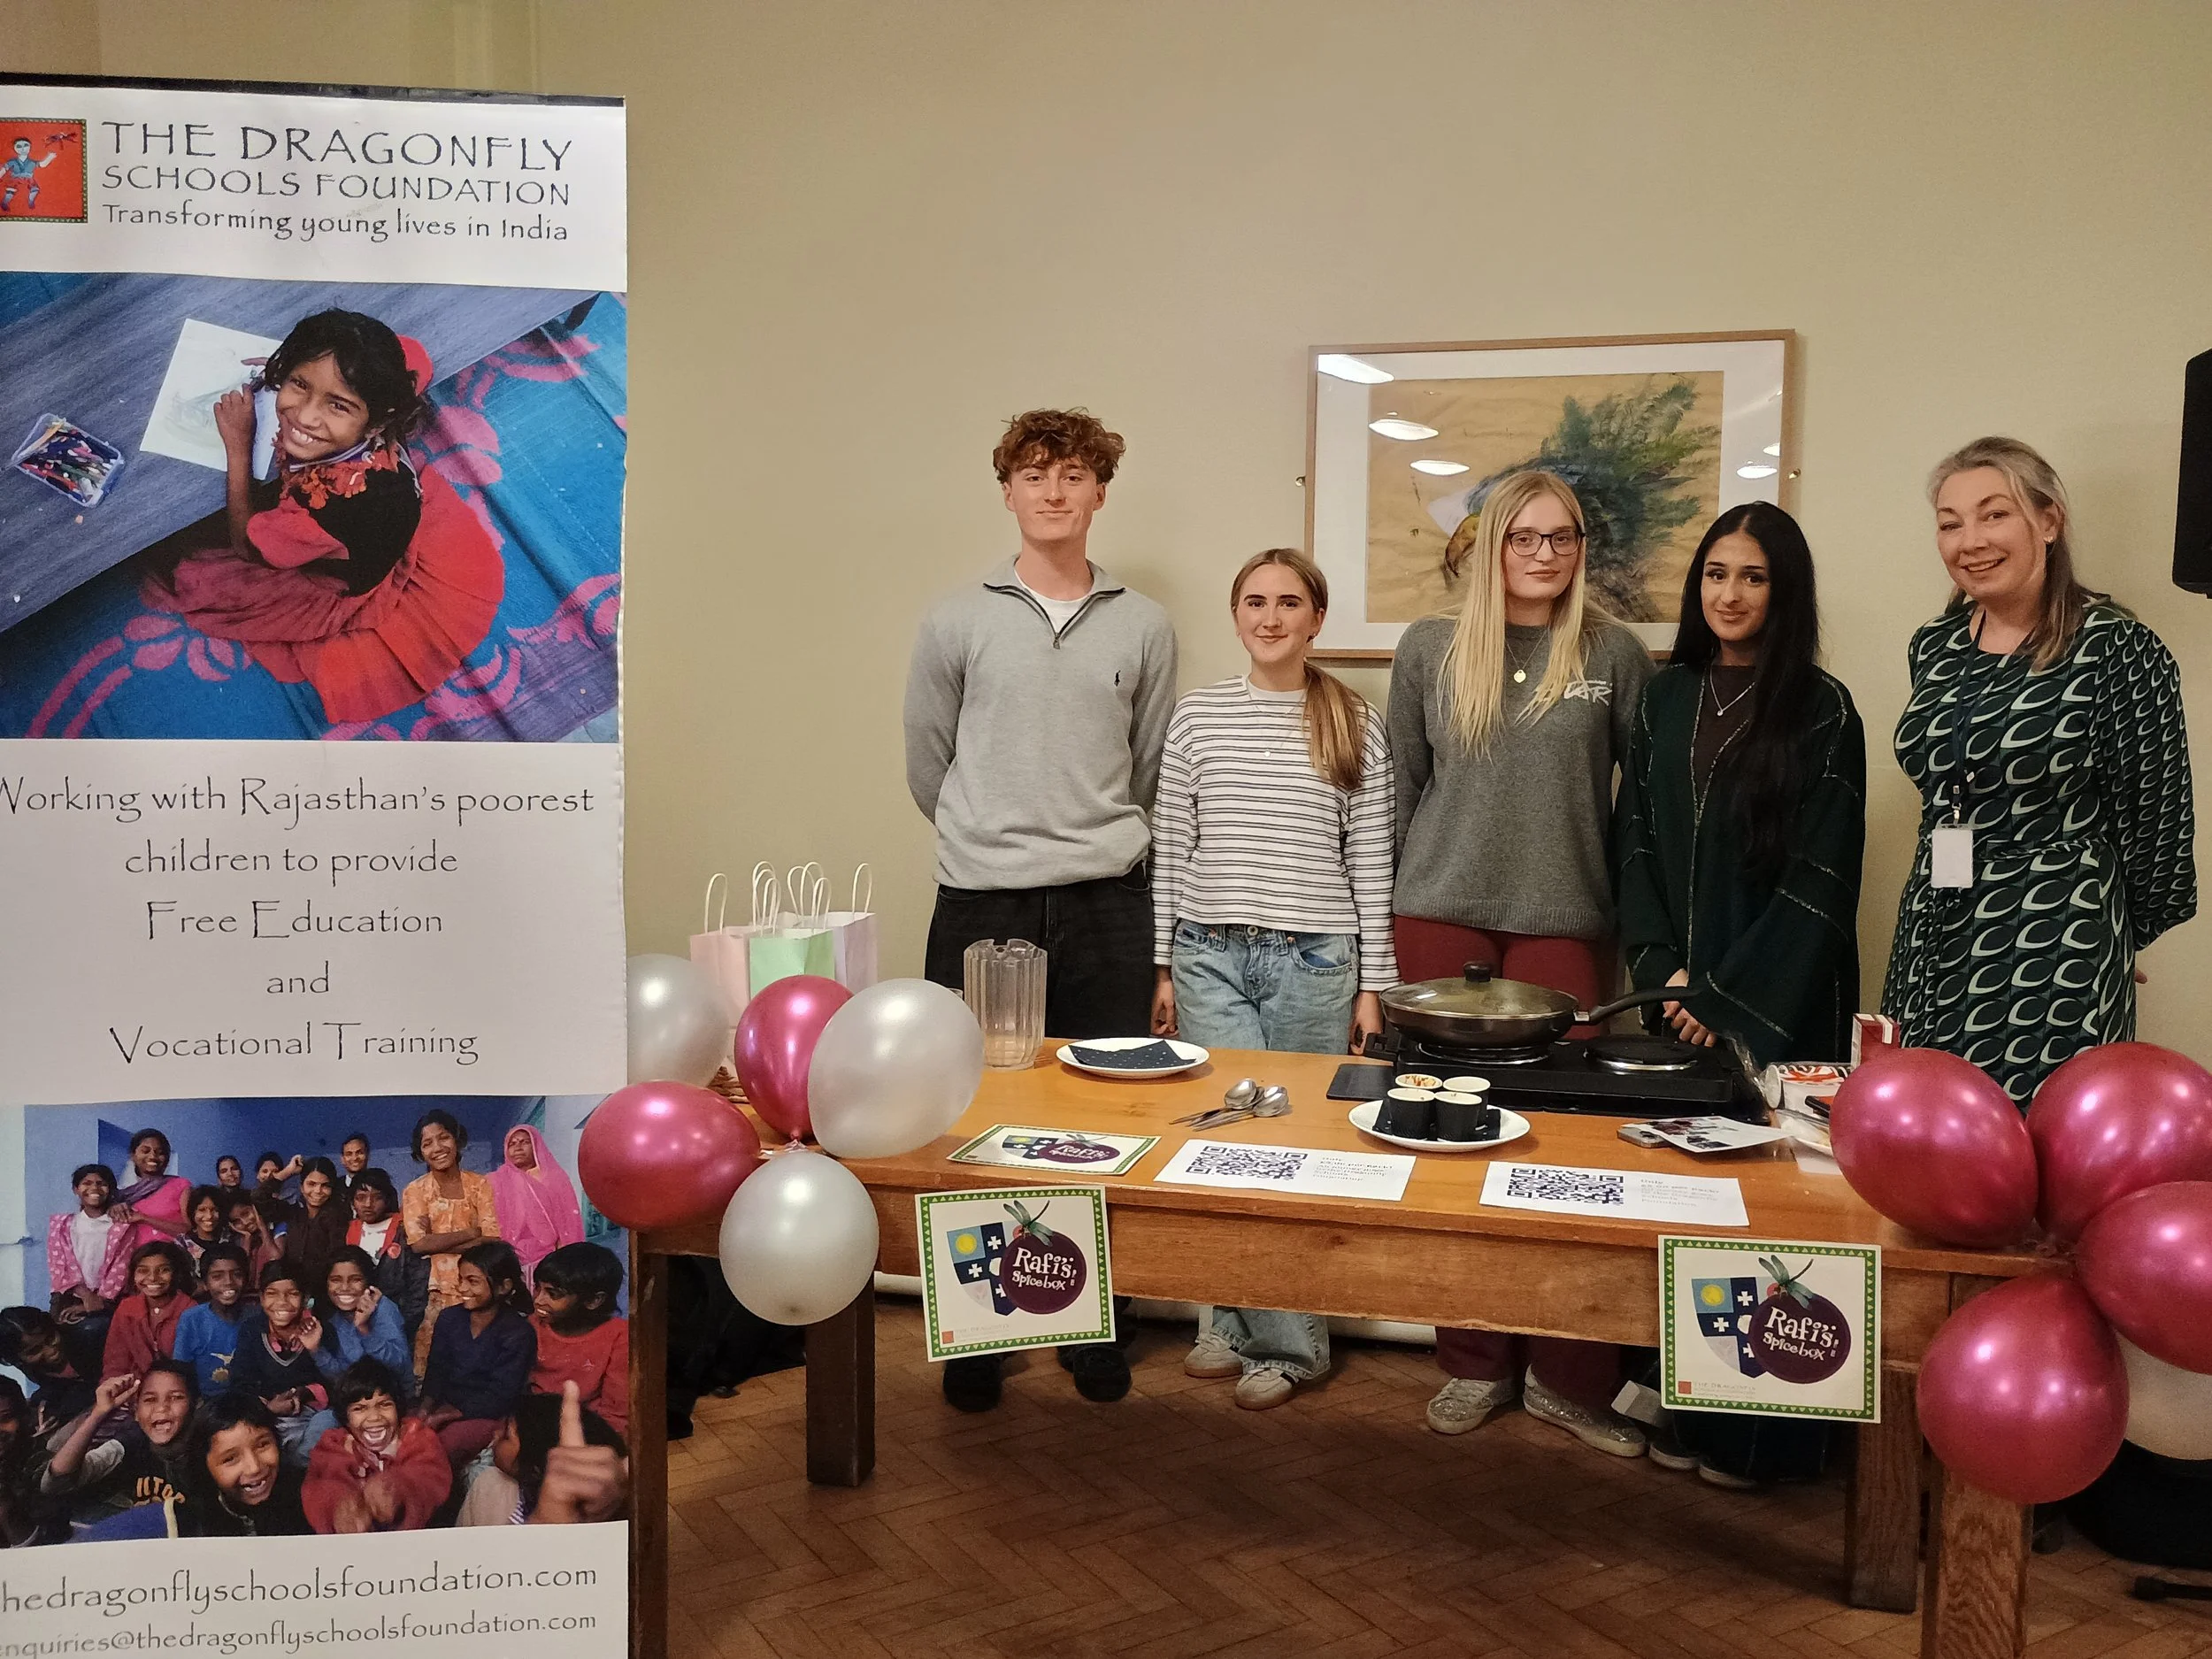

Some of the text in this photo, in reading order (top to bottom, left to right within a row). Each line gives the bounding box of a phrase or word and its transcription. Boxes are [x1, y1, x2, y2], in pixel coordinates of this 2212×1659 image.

[102, 121, 572, 173] THE DRAGONFLY
[103, 165, 568, 205] SCHOOLS FOUNDATION
[102, 199, 567, 243] Transforming young lives in India
[151, 776, 225, 809] with
[242, 777, 445, 830] Rajasthan's
[458, 789, 594, 826] poorest
[126, 838, 457, 887] children to provide
[147, 899, 442, 940] Free Education
[267, 961, 328, 994] and
[110, 1021, 478, 1065] Vocational Training
[2, 1560, 597, 1617] hedragonflyschoolsfoundation.com
